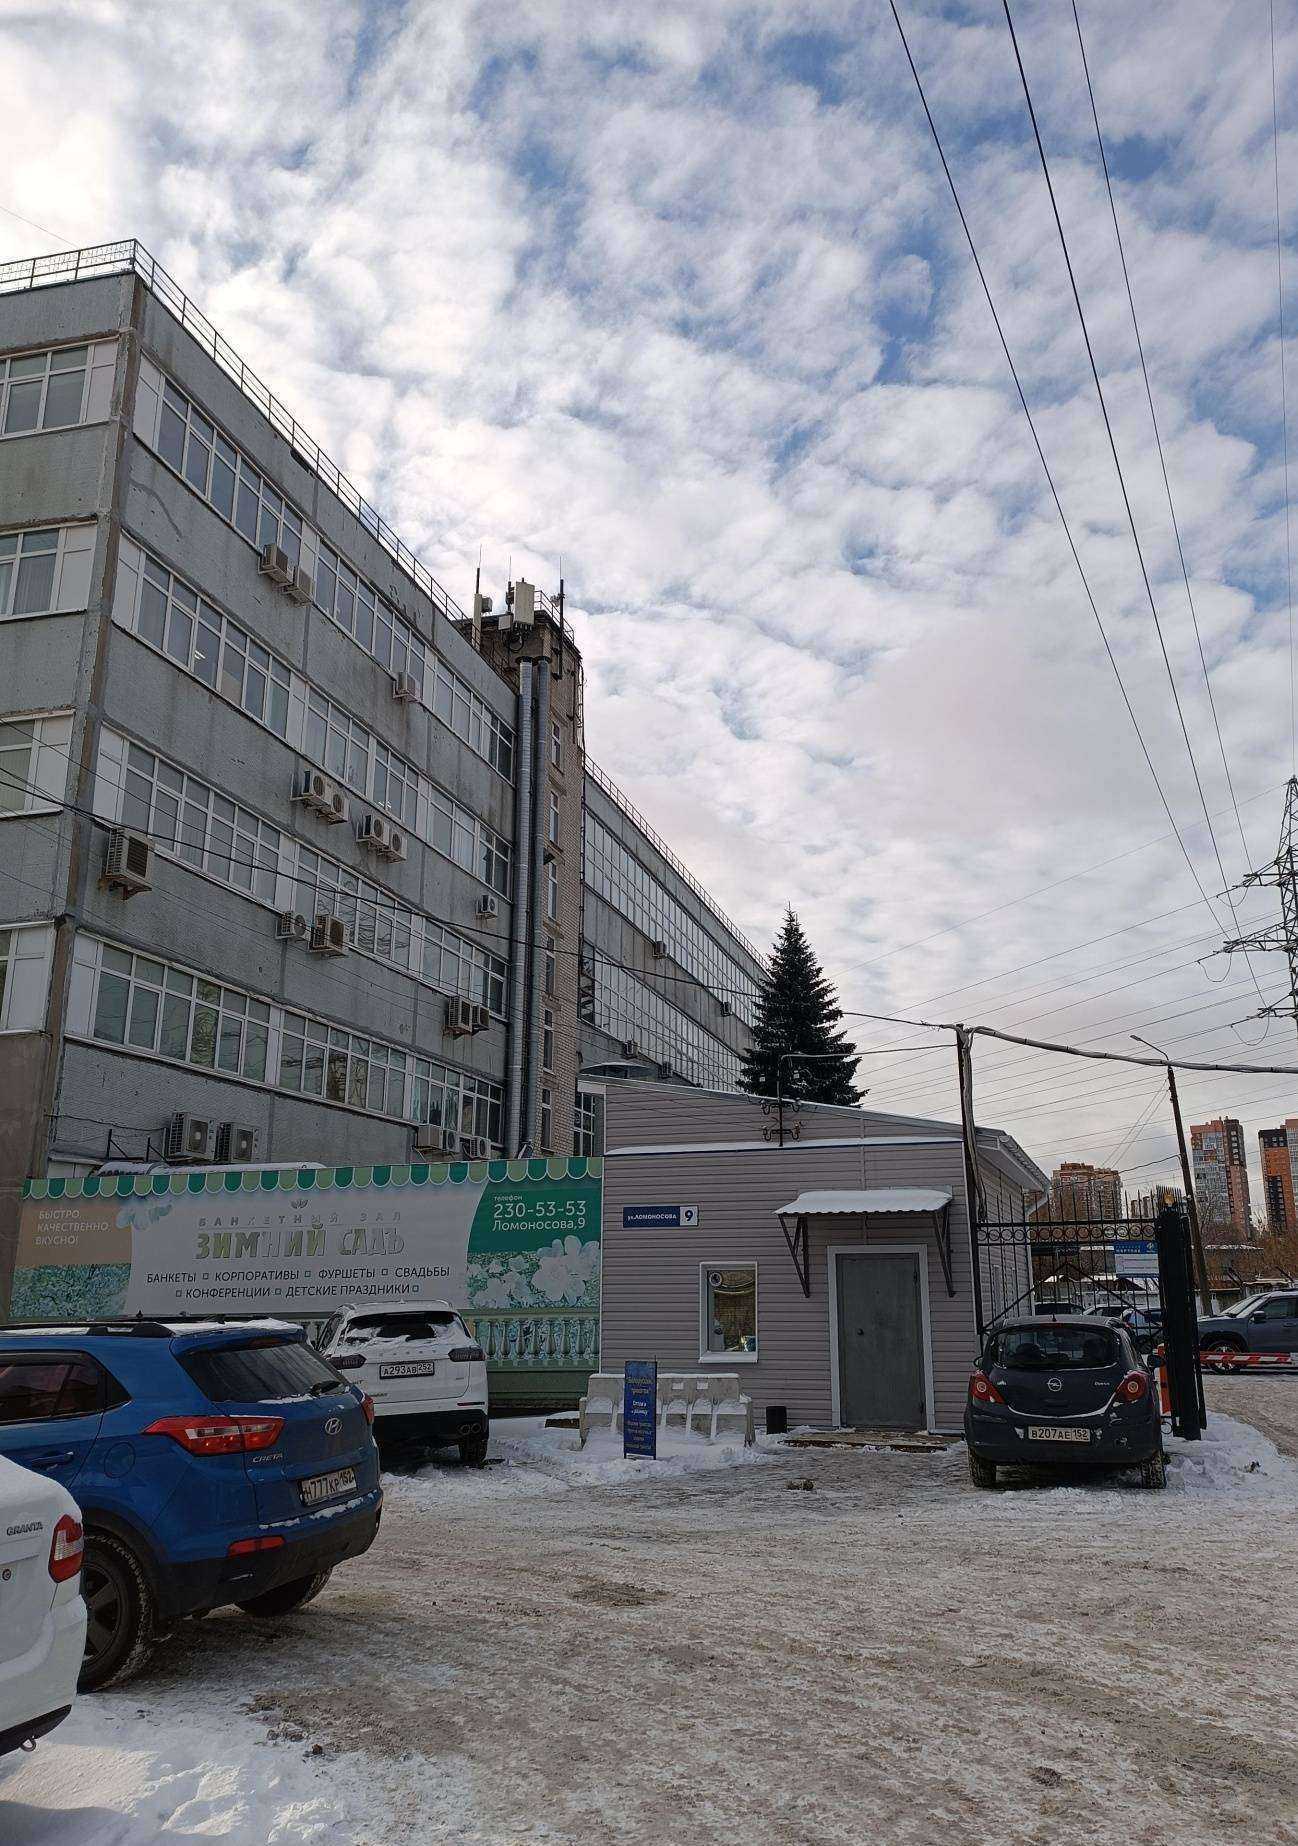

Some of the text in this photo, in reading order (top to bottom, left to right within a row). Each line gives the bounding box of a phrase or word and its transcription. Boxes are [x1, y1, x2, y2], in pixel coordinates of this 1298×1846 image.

[493, 1200, 587, 1218] 230-53-53
[684, 1209, 694, 1222] 9
[491, 1217, 586, 1232] Ломоносова,9
[195, 1222, 405, 1260] ЗИМНИЙ САДЪ
[146, 1265, 451, 1284] БАНКЕТЫ КОРПОРАТИВЫ ФУРШЕТЫ СВАДЬБЫ
[184, 1283, 411, 1300] КОНФЕРЕНЦИИ ДЕТСКИЕ ПРАЗДНИКИ
[418, 1362, 432, 1372] 252
[1073, 1429, 1088, 1439] 152
[6, 1521, 44, 1536] GRANTA
